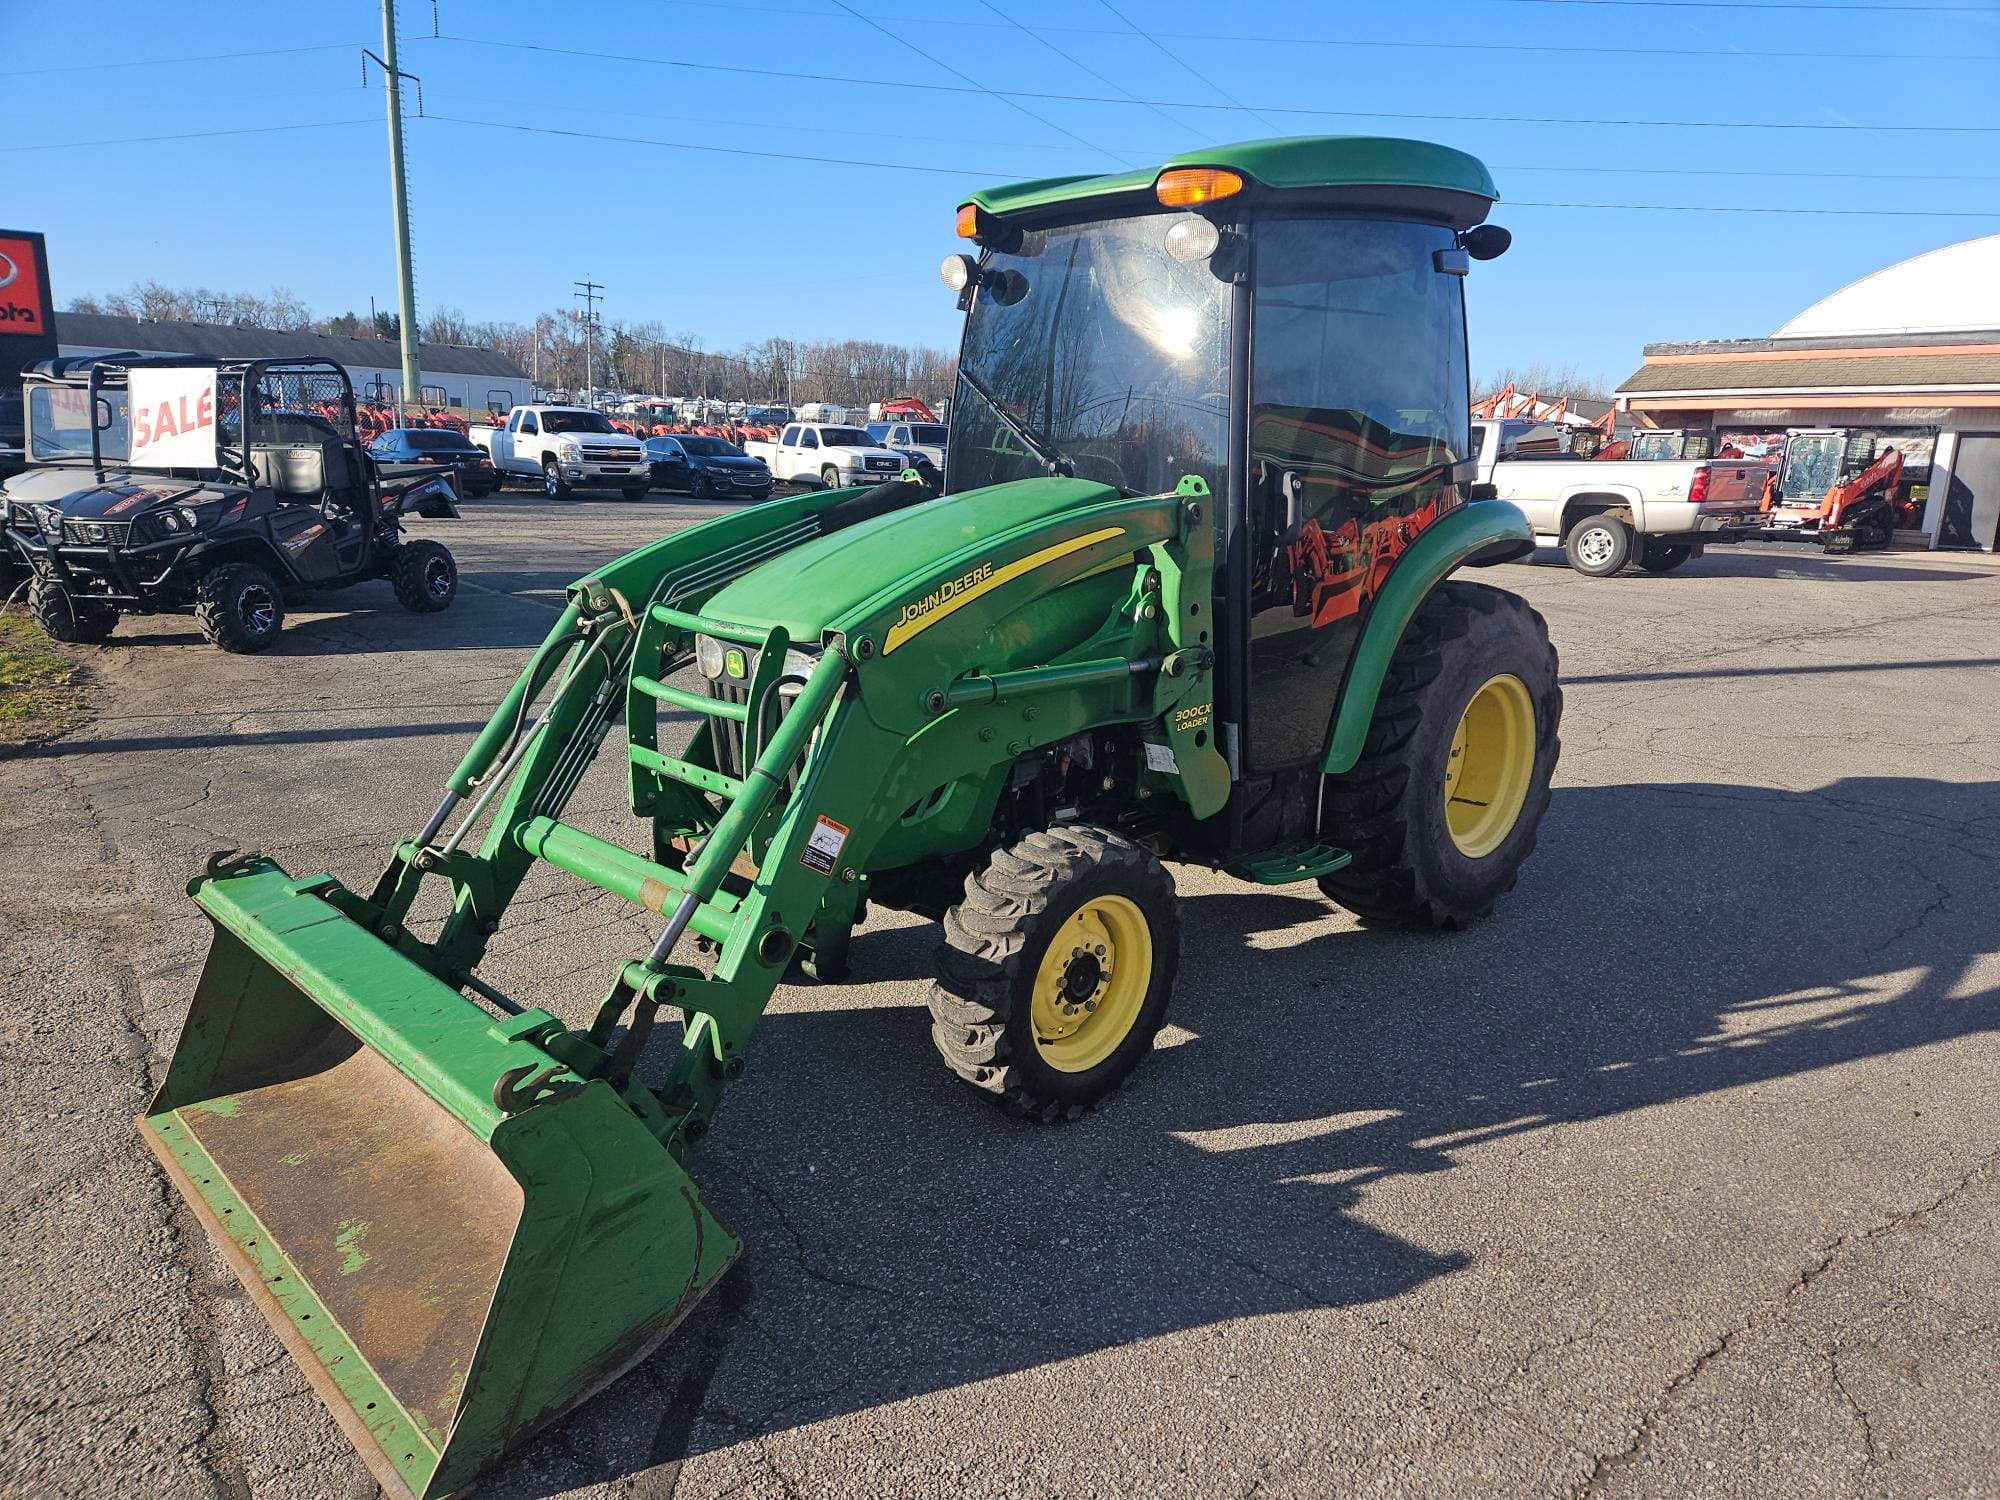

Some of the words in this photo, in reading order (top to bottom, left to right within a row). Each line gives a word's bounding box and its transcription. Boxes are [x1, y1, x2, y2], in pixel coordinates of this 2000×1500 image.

[134, 386, 213, 448] SALE
[896, 591, 941, 628] JOHN
[941, 562, 994, 604] DEERE
[1175, 703, 1212, 722] 300CX
[1177, 716, 1208, 732] LOADER
